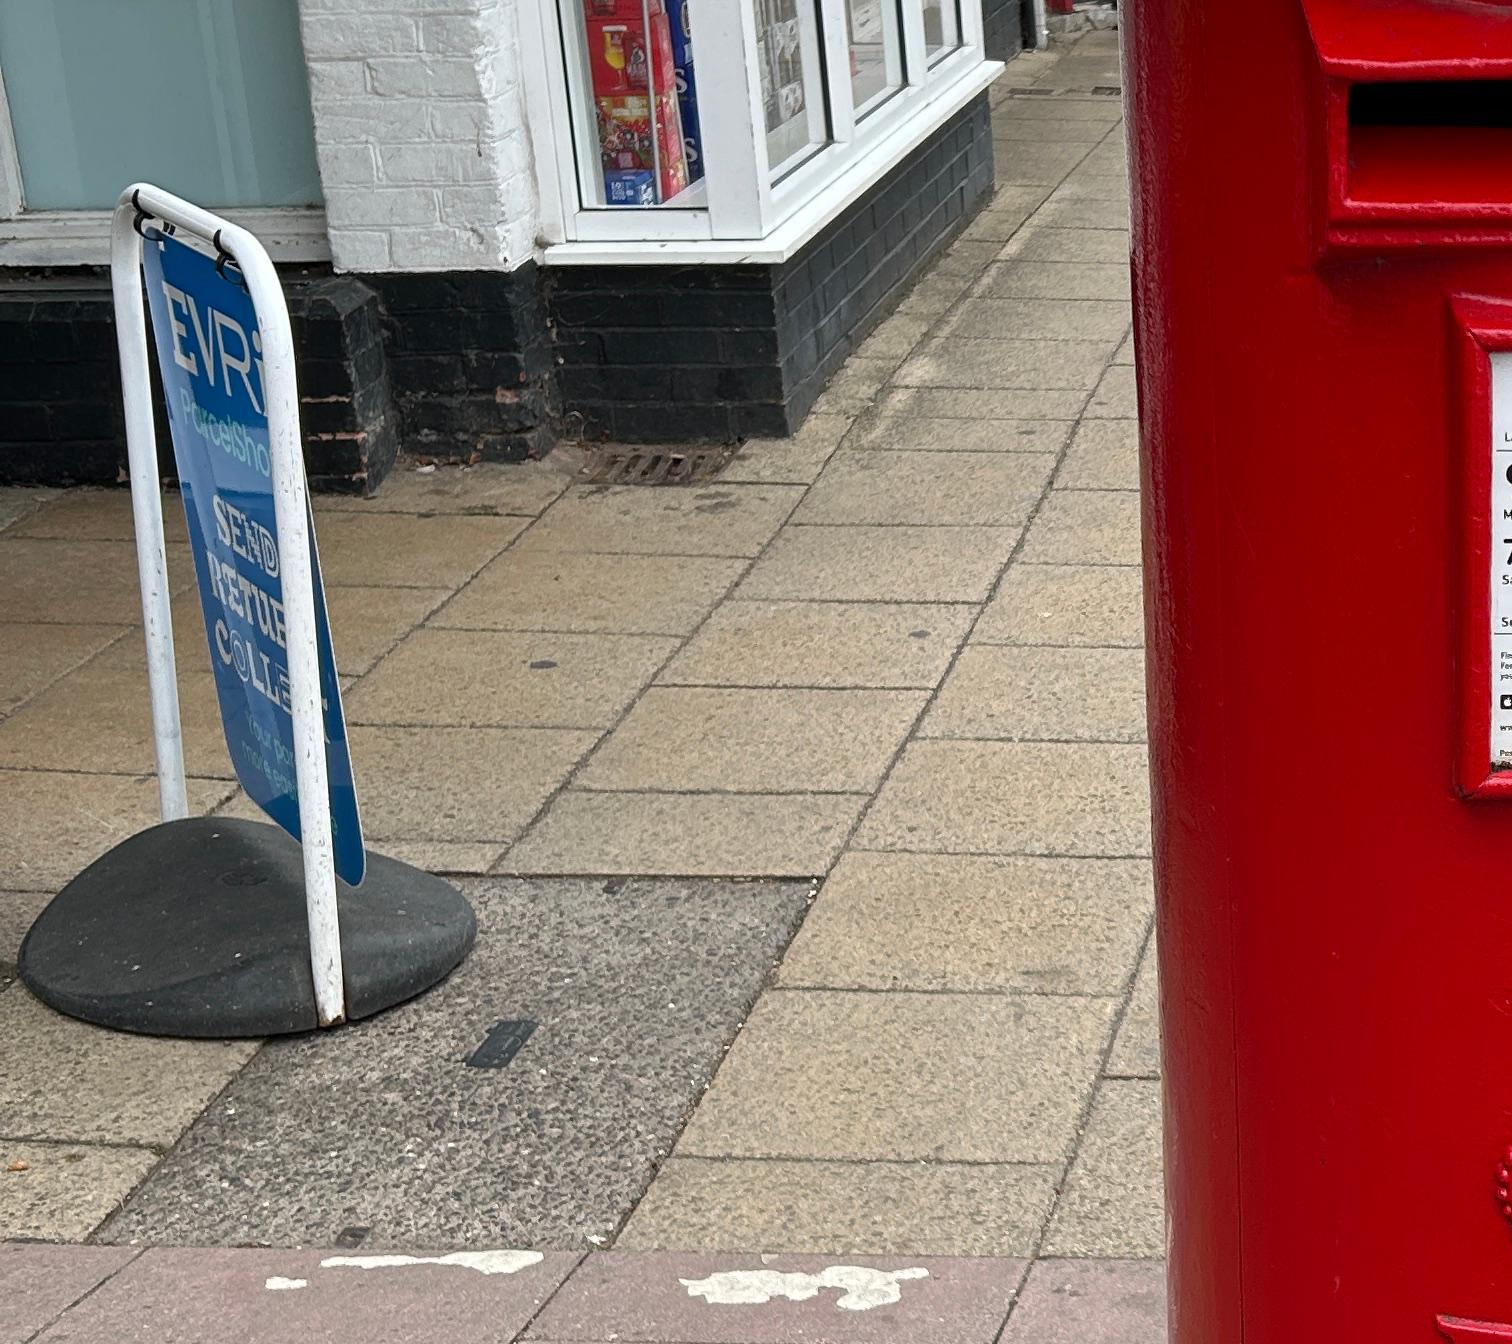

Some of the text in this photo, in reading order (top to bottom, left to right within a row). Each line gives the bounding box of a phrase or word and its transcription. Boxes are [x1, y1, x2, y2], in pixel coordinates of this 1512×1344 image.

[180, 388, 272, 477] ParcelSho
[212, 494, 280, 579] SEND
[206, 551, 287, 650] RETU
